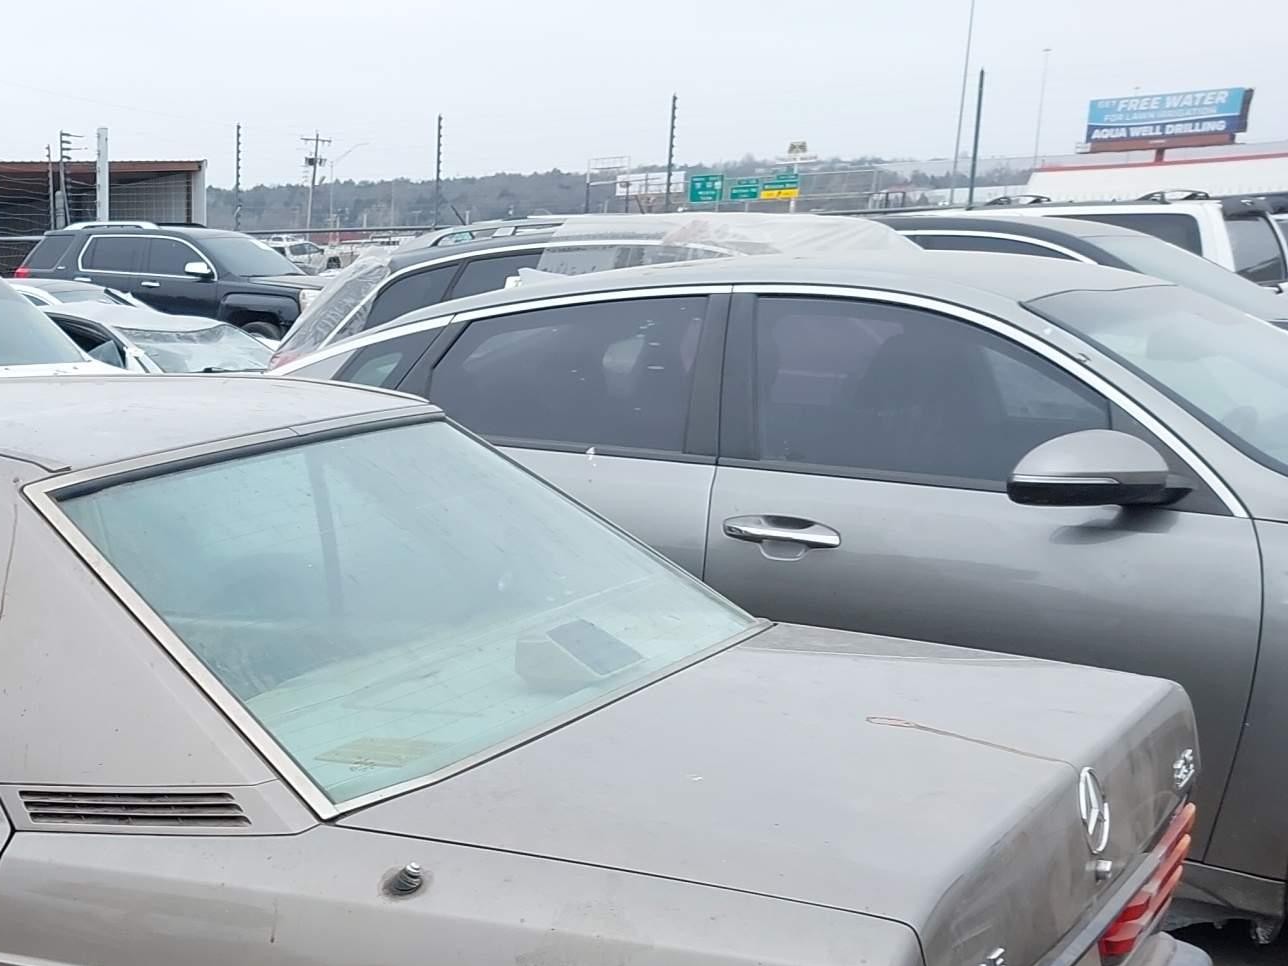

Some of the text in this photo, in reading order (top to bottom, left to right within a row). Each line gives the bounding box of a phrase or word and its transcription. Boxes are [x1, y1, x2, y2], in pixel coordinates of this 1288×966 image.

[1118, 98, 1160, 112] FREE
[1166, 91, 1229, 107] WATER
[1103, 113, 1124, 122] FOR
[1125, 112, 1155, 121] LAWN
[1092, 121, 1226, 139] AQUA WELL DRILLING
